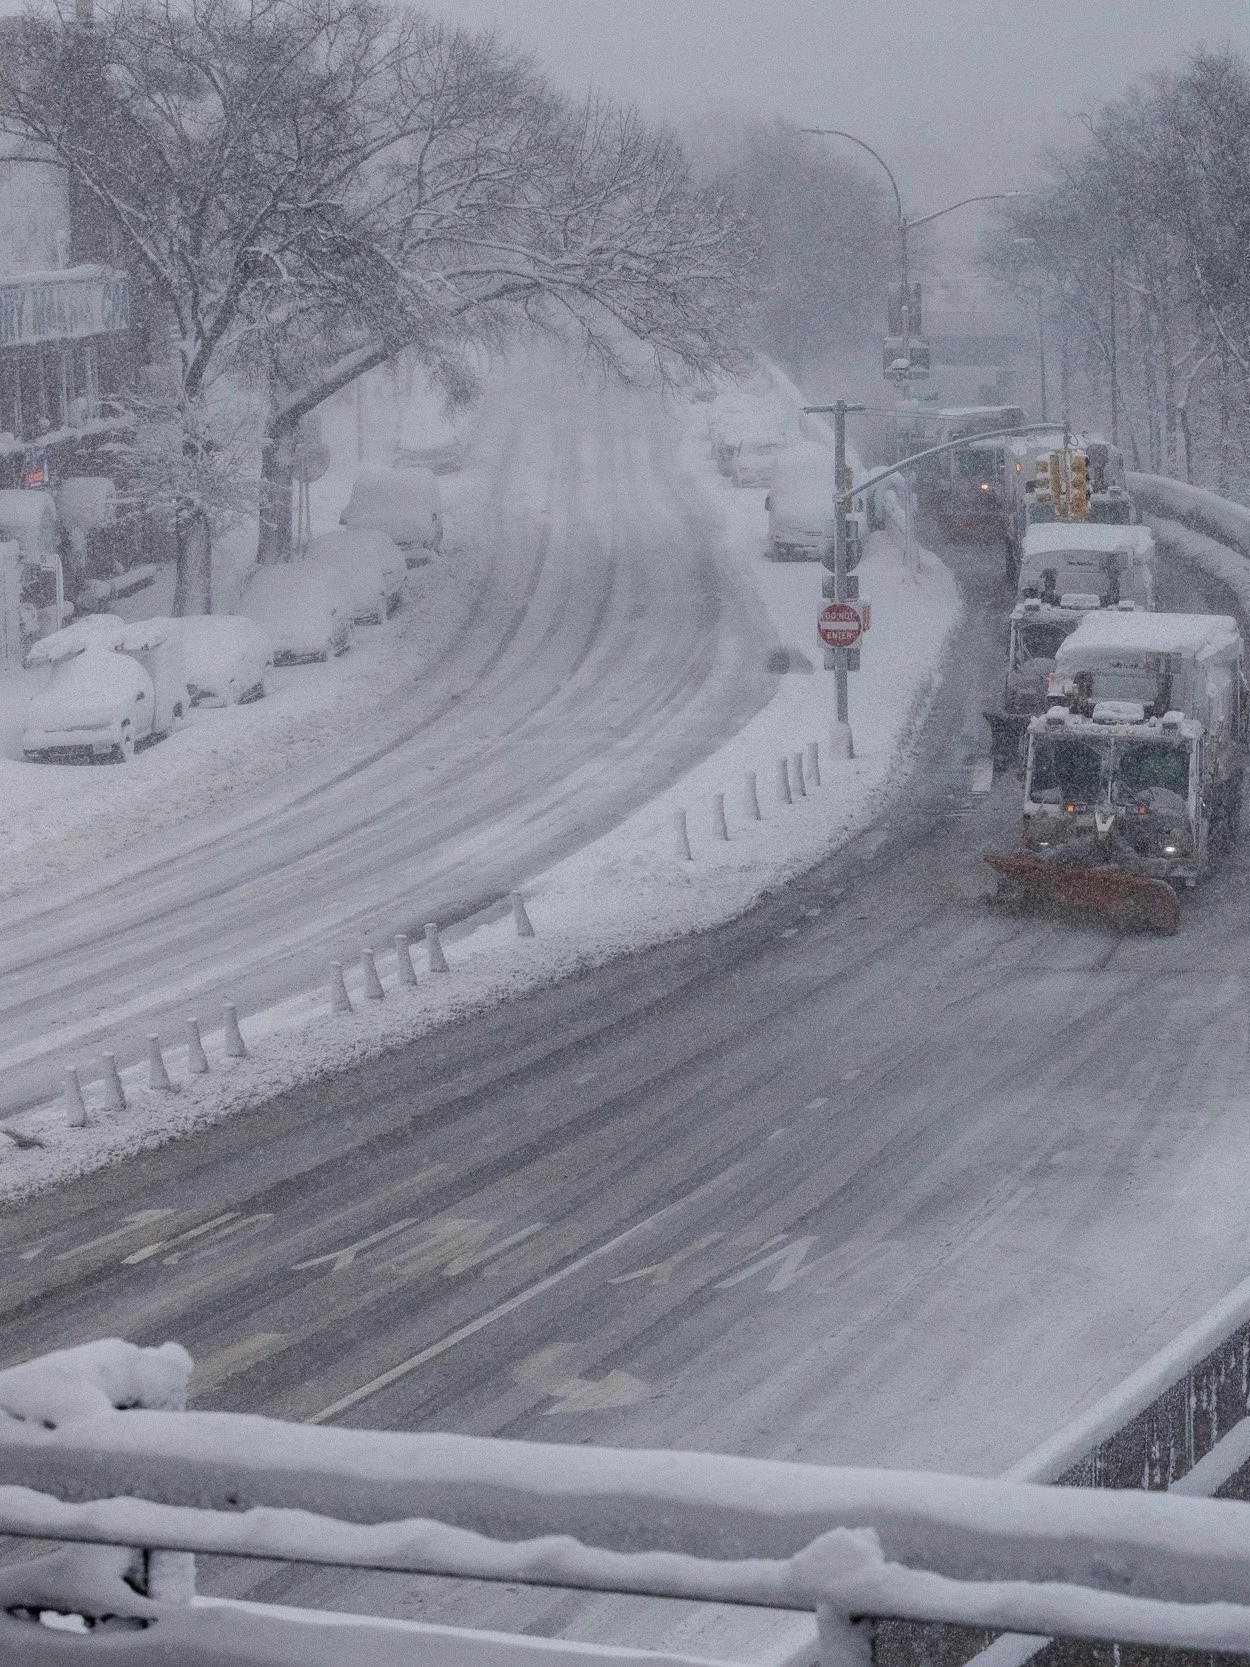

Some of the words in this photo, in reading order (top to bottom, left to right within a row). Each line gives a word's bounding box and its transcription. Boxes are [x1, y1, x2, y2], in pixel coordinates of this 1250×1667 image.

[825, 612, 835, 620] DO
[839, 612, 854, 620] NOT
[827, 631, 853, 640] ENTER
